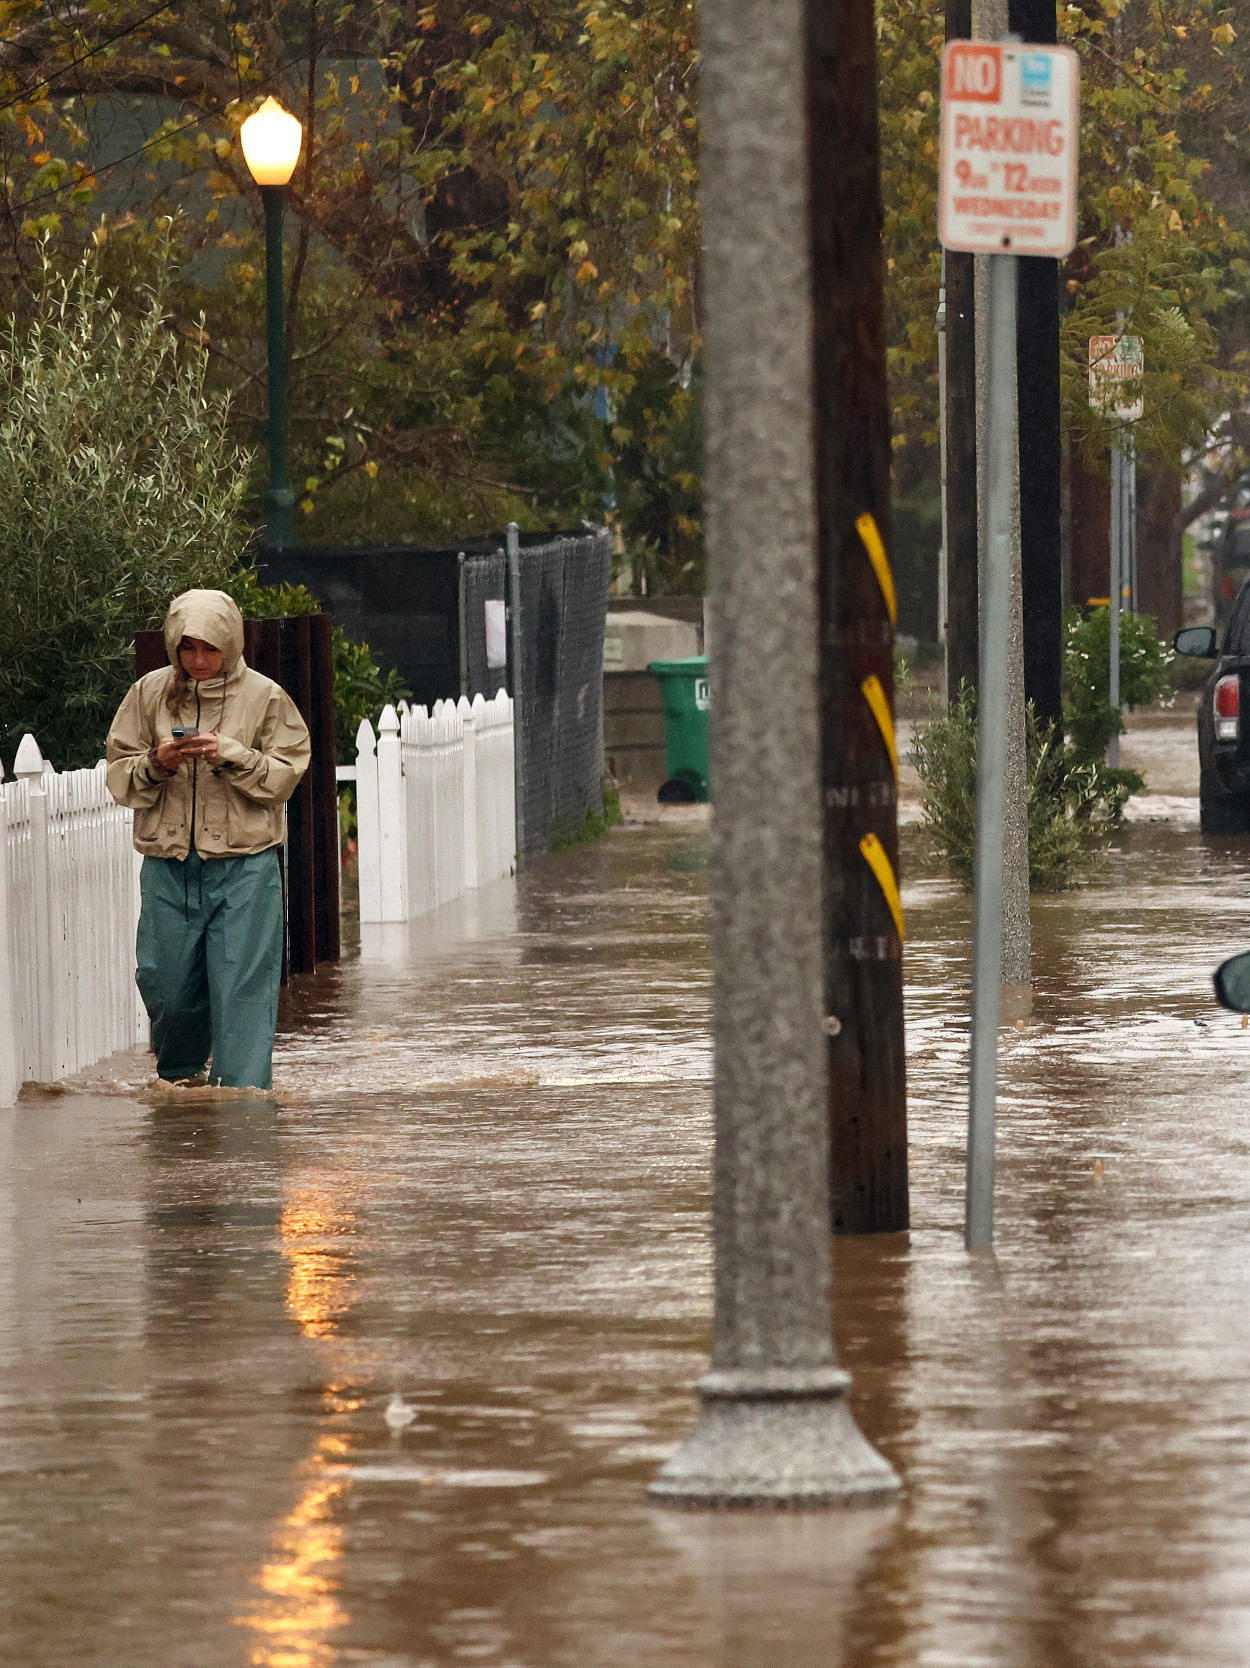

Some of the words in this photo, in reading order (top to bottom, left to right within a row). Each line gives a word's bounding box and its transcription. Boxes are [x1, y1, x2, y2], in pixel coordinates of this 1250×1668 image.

[954, 54, 996, 95] NO
[954, 114, 1063, 156] PARKING
[953, 197, 1061, 220] WEDNESDAY
